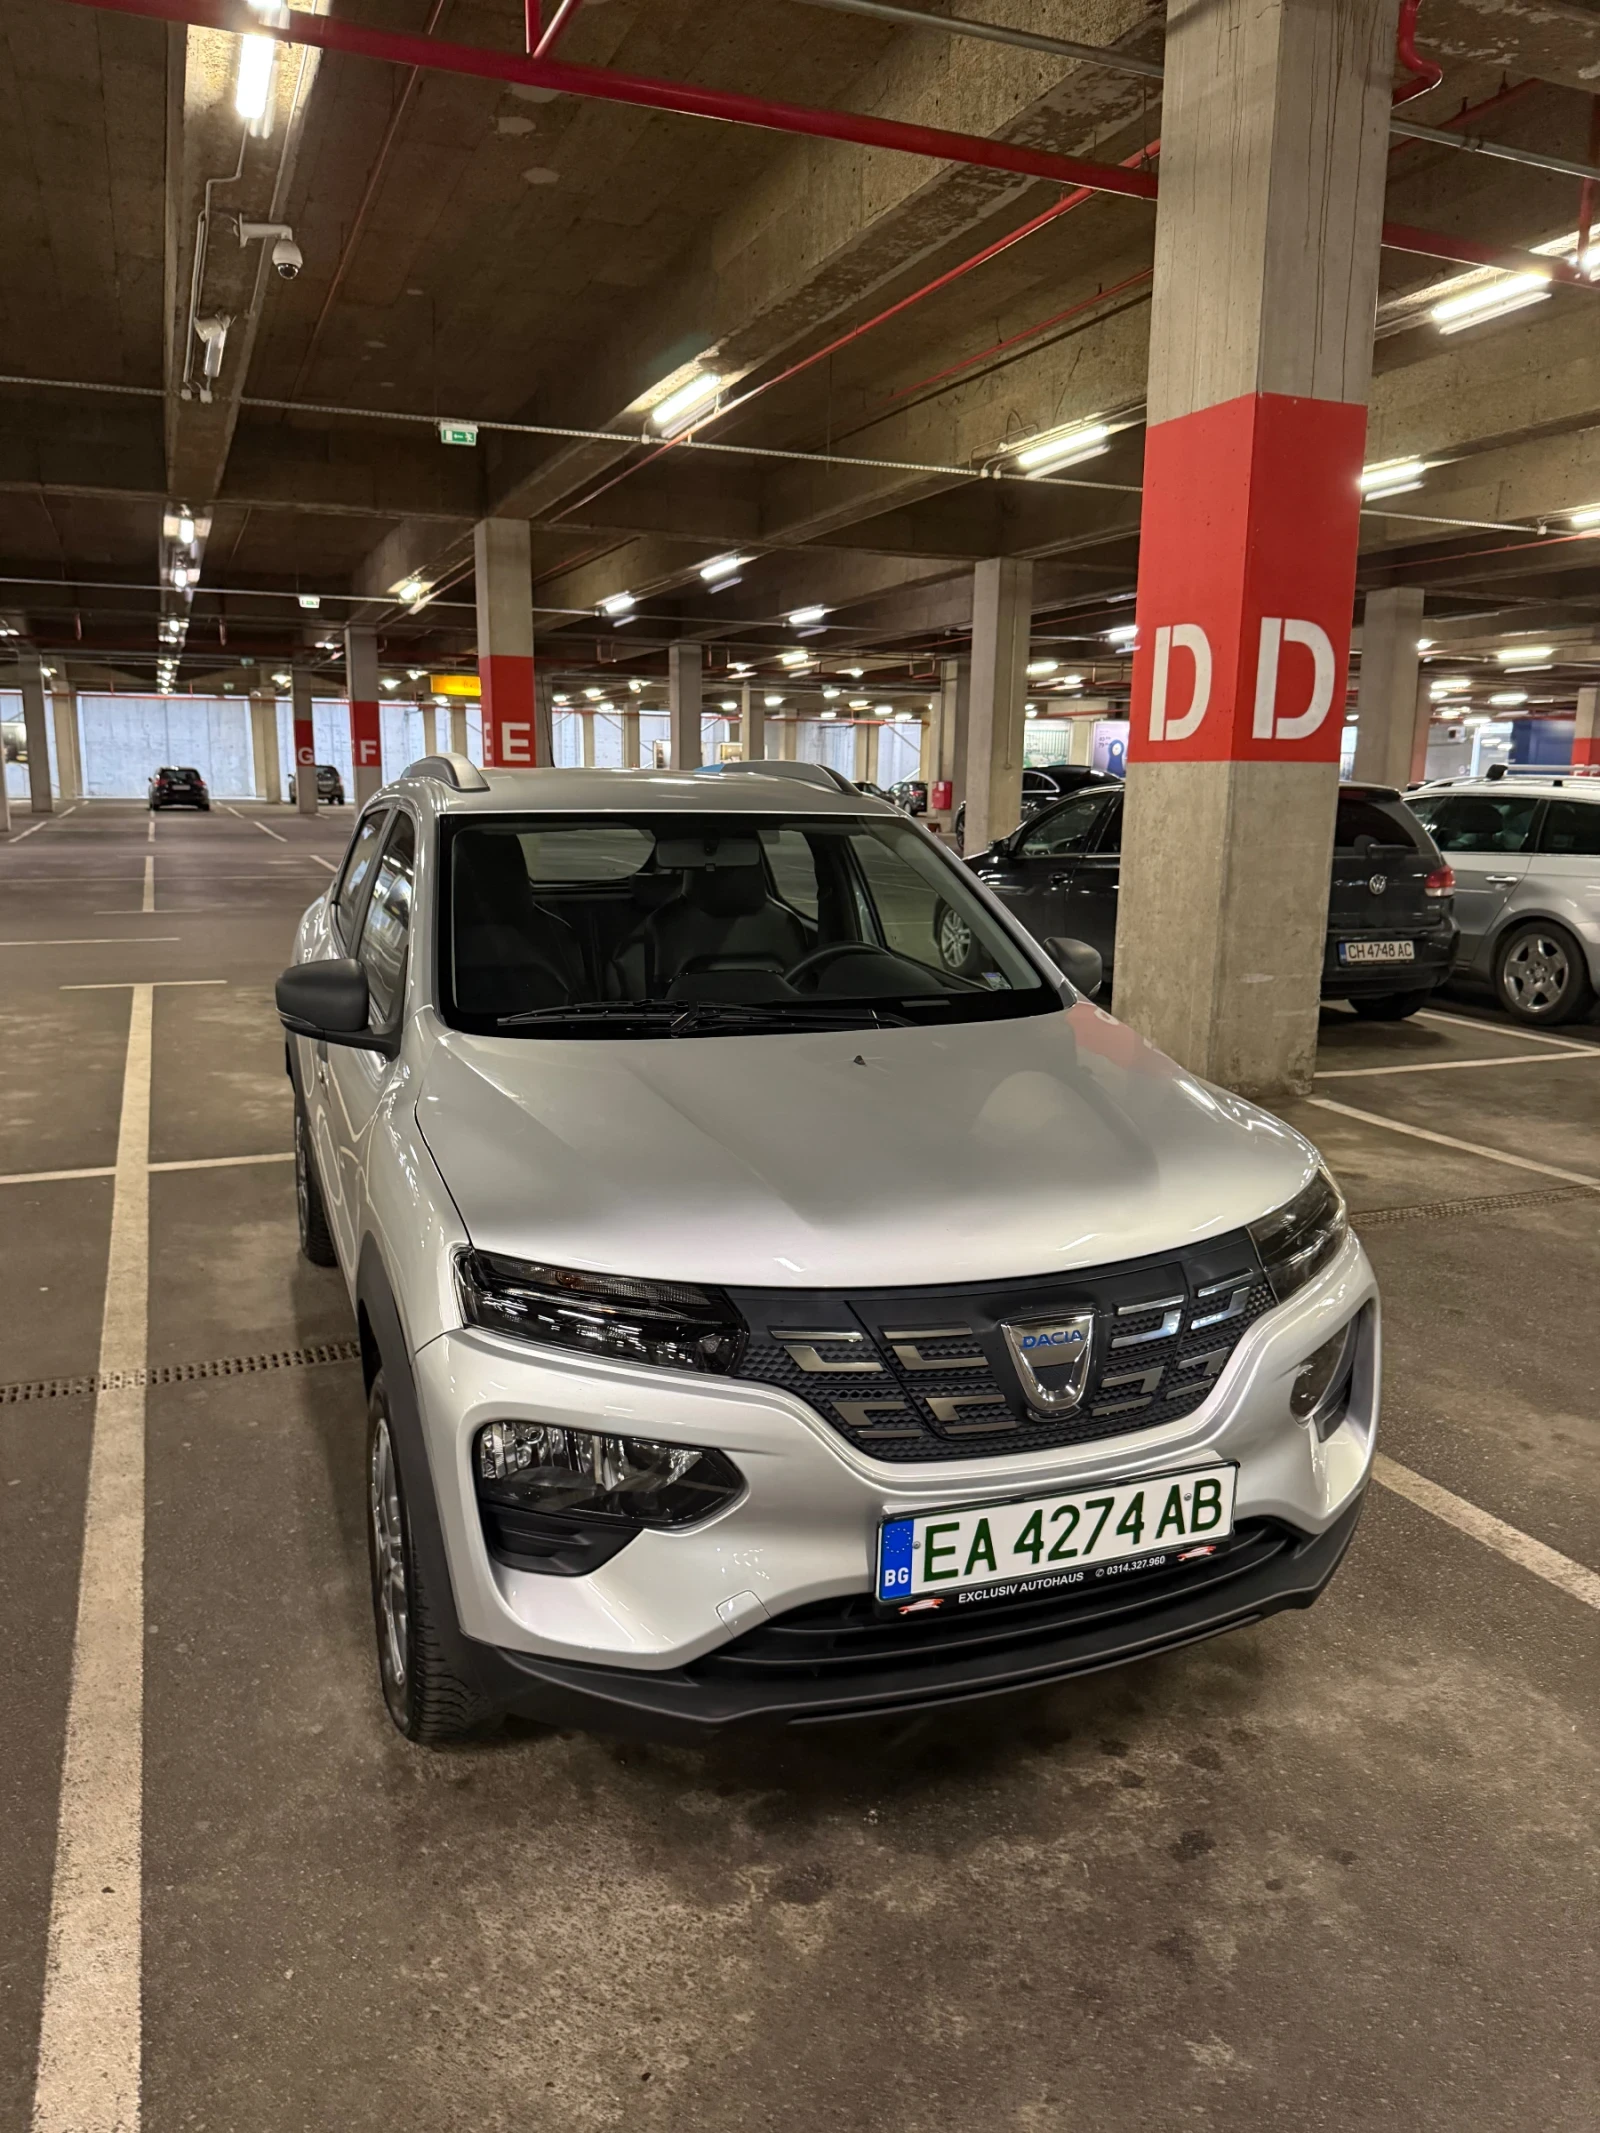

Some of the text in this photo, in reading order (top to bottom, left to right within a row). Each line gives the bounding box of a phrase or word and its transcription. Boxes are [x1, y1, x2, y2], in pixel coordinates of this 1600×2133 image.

[1148, 623, 1212, 742] D
[1251, 617, 1336, 740] D
[298, 747, 315, 764] G
[361, 740, 377, 764] F
[502, 722, 531, 762] E
[1348, 944, 1366, 959] CH
[1367, 943, 1396, 958] 4748
[1398, 942, 1412, 957] AC
[1021, 1329, 1084, 1349] DACIA
[922, 1478, 1223, 1583] EA 4274 AB
[884, 1567, 910, 1588] BG
[958, 1555, 1166, 1604] EXCLUSIV AUTOHAUS 0314.327.960
